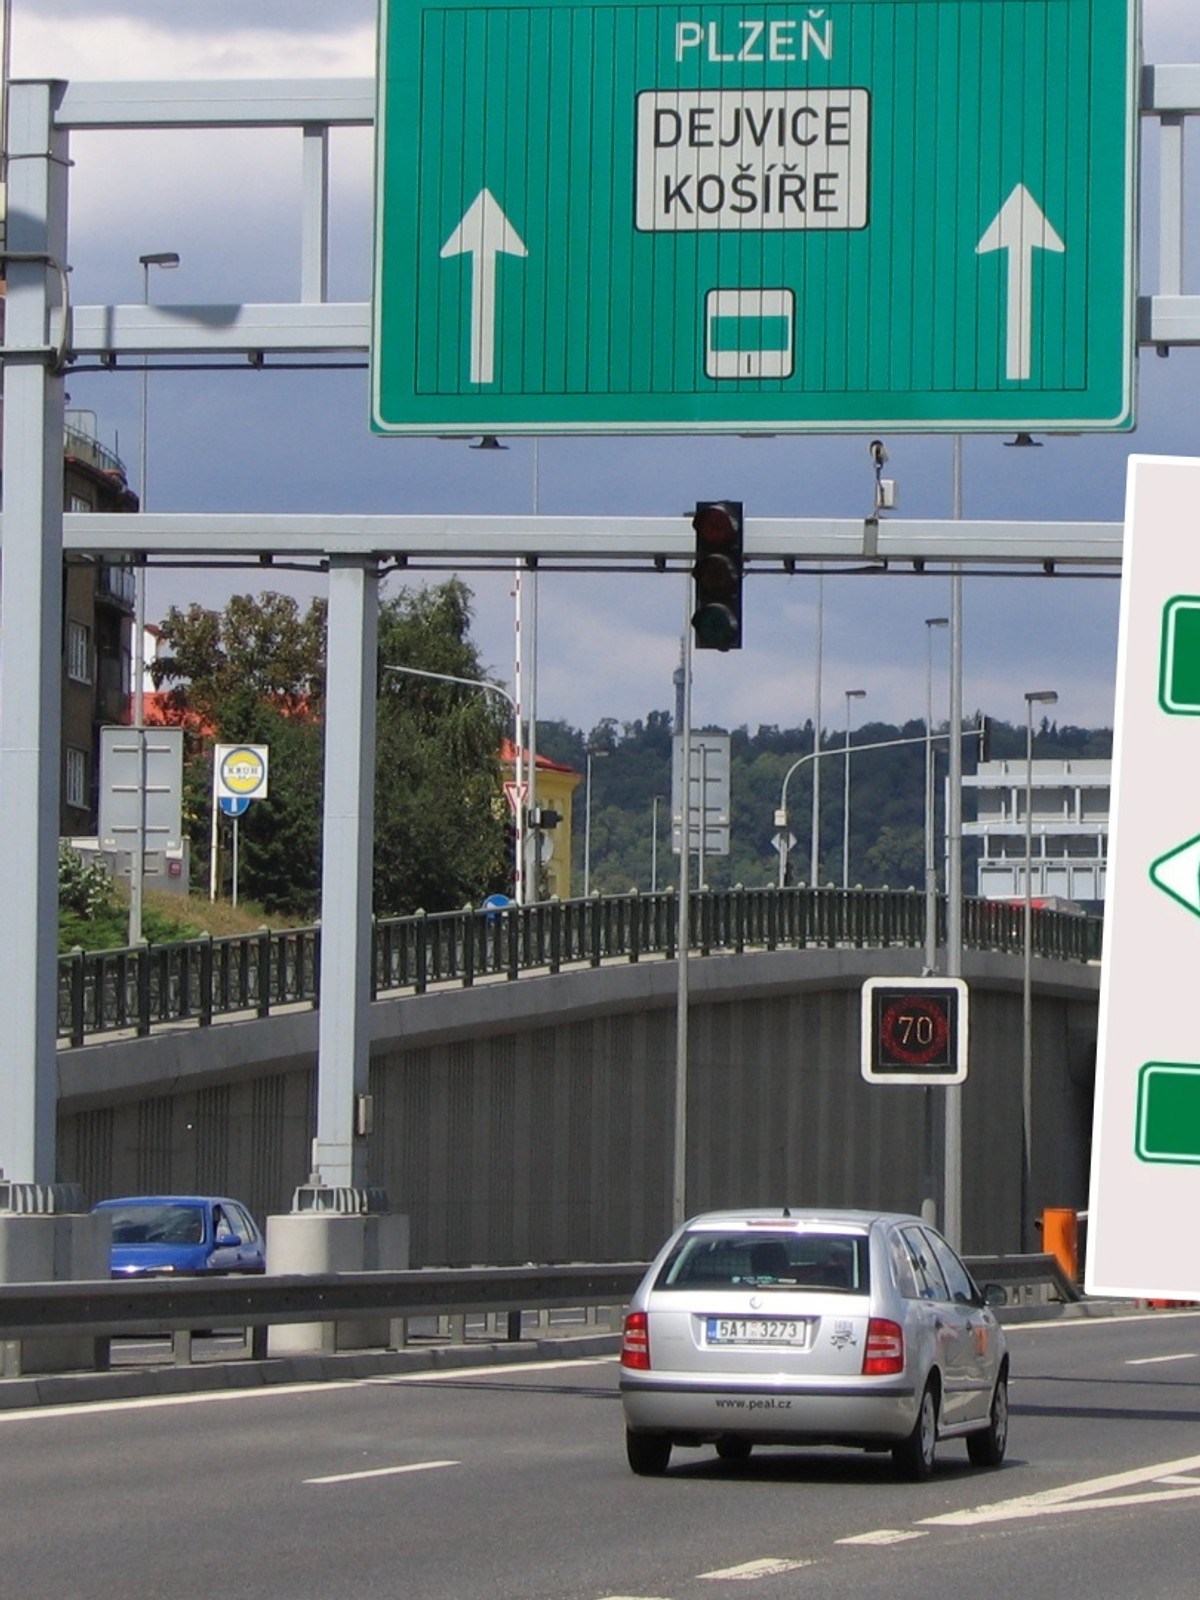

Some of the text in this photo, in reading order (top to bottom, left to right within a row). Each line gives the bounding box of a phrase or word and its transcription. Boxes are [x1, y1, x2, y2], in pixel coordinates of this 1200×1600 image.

[675, 10, 833, 62] PLZEŇ
[653, 106, 851, 149] DEJVICE
[664, 164, 839, 214] KOŠÍŘE
[899, 1016, 932, 1044] 70
[720, 1321, 797, 1338] 5A1 3273
[715, 1398, 792, 1411] www.peal.cz
